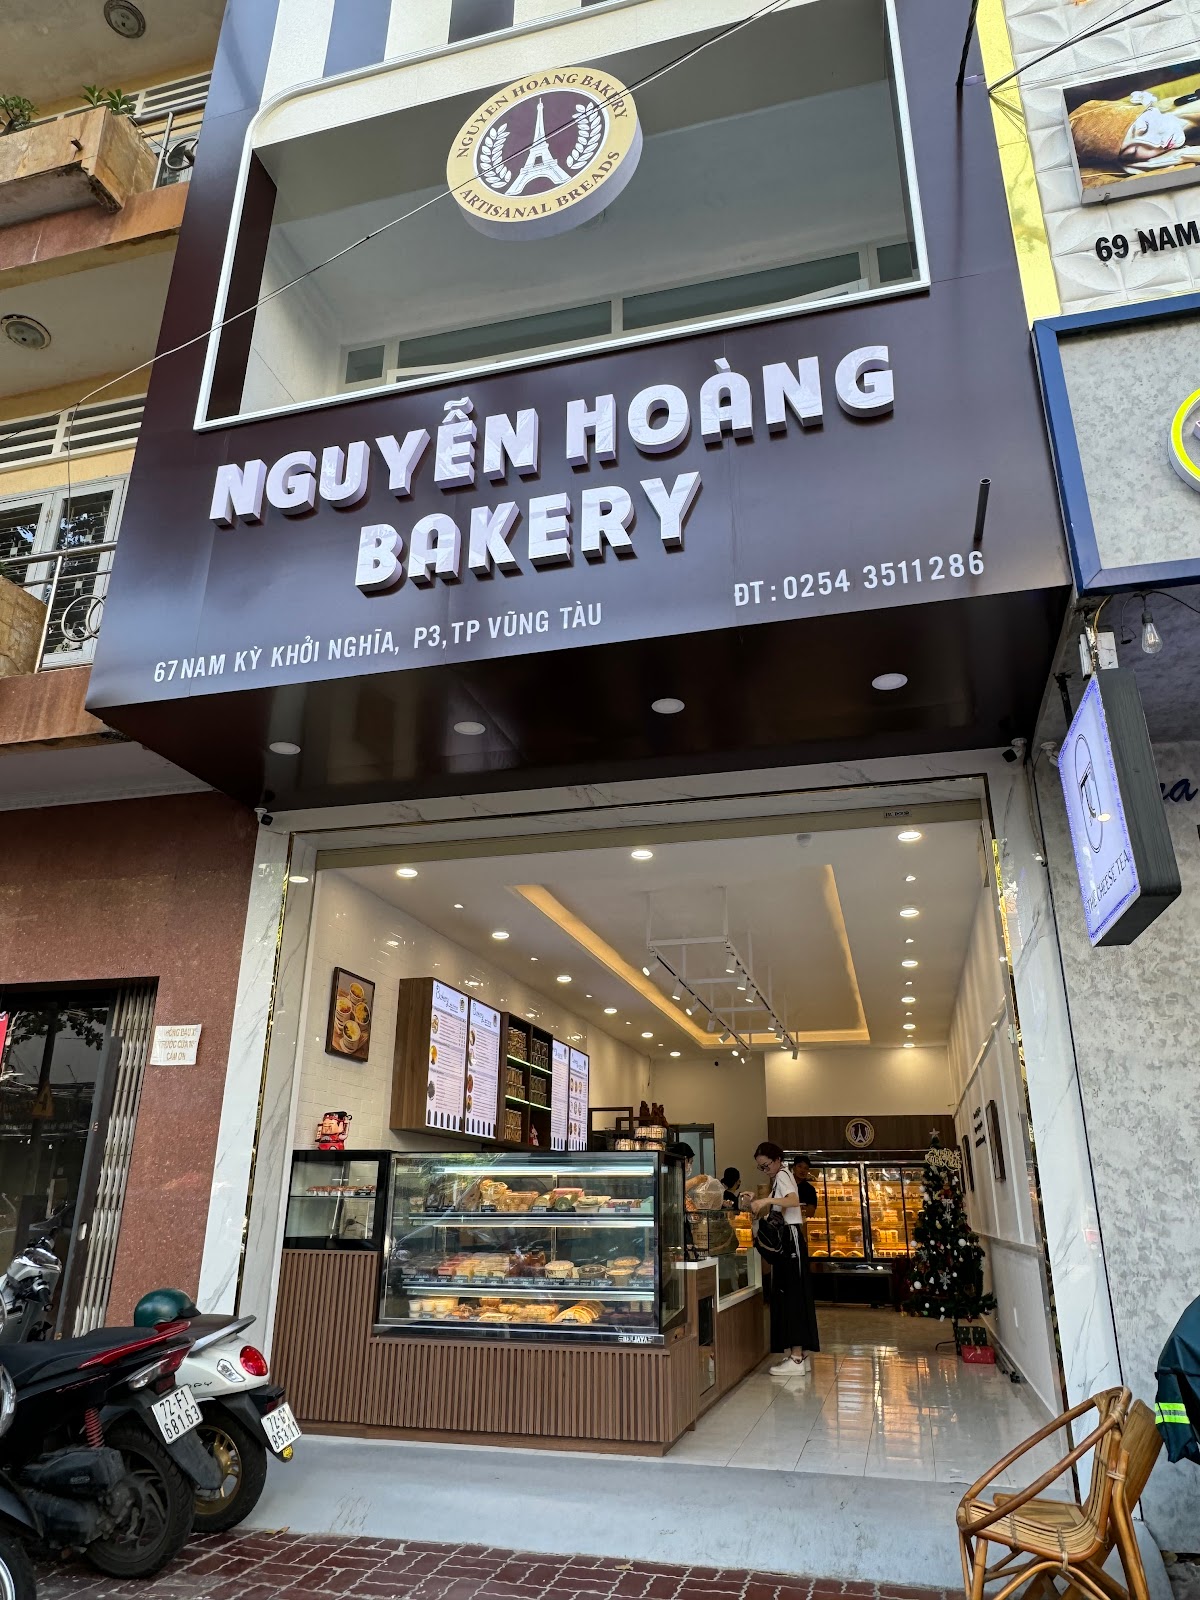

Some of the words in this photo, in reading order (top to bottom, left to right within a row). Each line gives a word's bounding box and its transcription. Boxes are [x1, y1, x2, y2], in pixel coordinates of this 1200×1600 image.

[457, 95, 509, 158] NGUYEN
[511, 73, 578, 98] HOANG
[579, 75, 628, 120] BAKERY
[459, 188, 552, 219] ARTISANAL
[556, 150, 620, 208] BREADS
[1095, 233, 1129, 262] 69
[1137, 220, 1200, 254] NAM
[209, 397, 540, 524] NGUYỄN
[566, 345, 894, 466] HOÀNG
[355, 471, 702, 592] BAKERY
[862, 550, 985, 589] 3511286
[234, 646, 262, 673] KỲ
[270, 635, 320, 668] KHỞI
[327, 628, 400, 661] NGHĨA,
[488, 610, 549, 639] VŨNG
[559, 600, 602, 630] TÀU
[159, 1389, 189, 1420] 72-F1
[164, 1404, 200, 1440] 681.63
